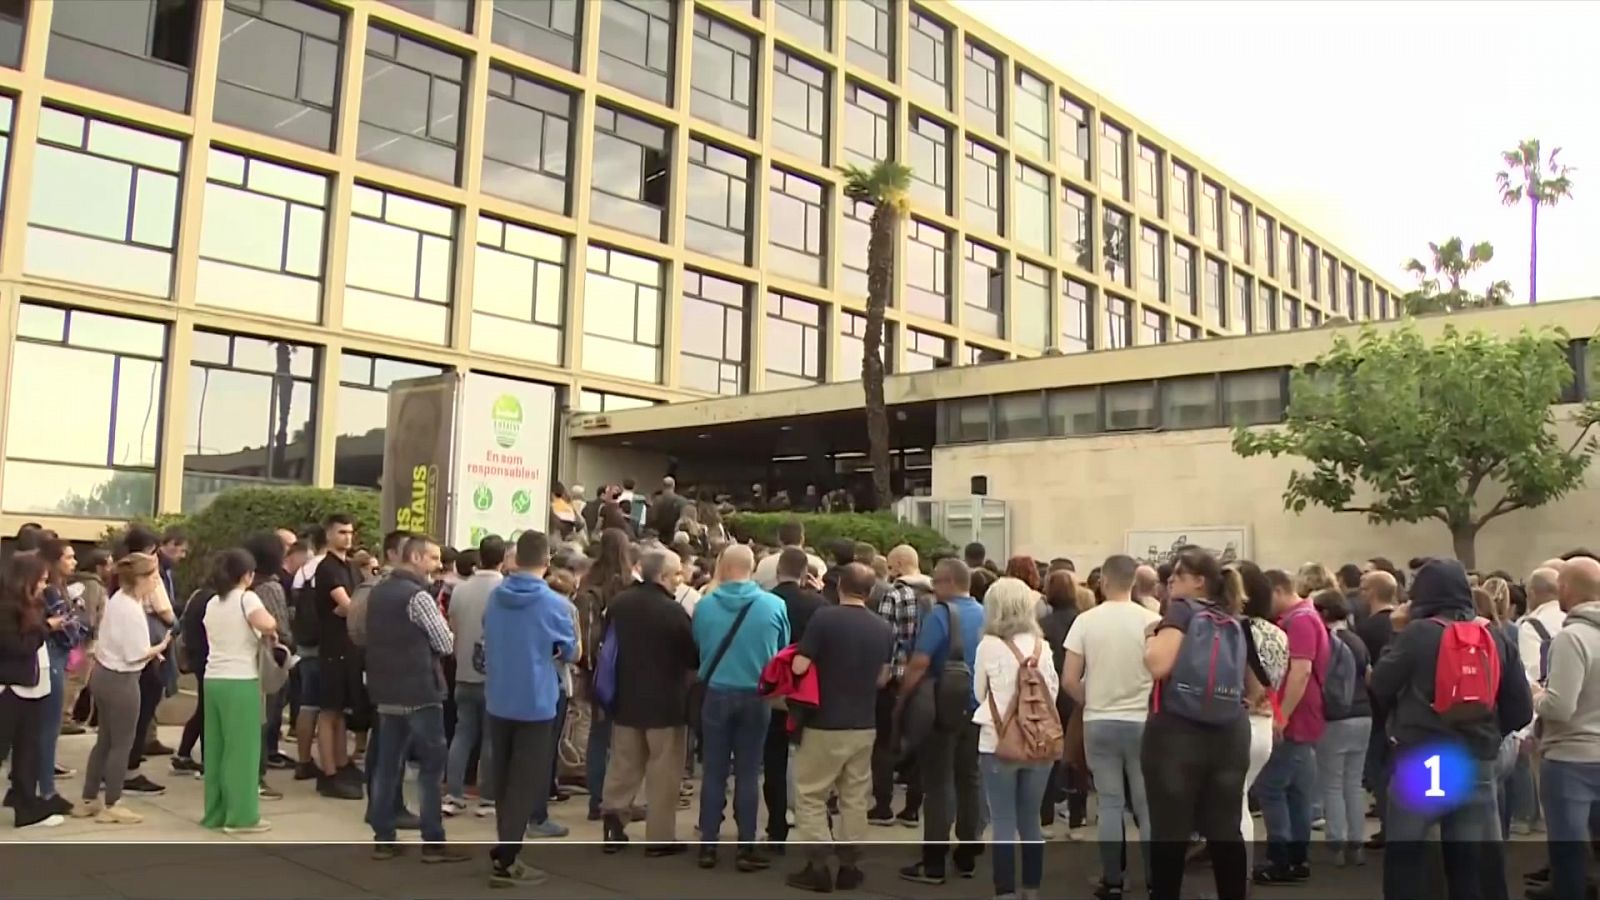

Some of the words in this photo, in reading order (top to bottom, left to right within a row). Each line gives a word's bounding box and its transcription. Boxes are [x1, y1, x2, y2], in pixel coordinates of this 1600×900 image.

[486, 450, 499, 462] En
[501, 455, 523, 465] som
[467, 463, 540, 480] responsables!
